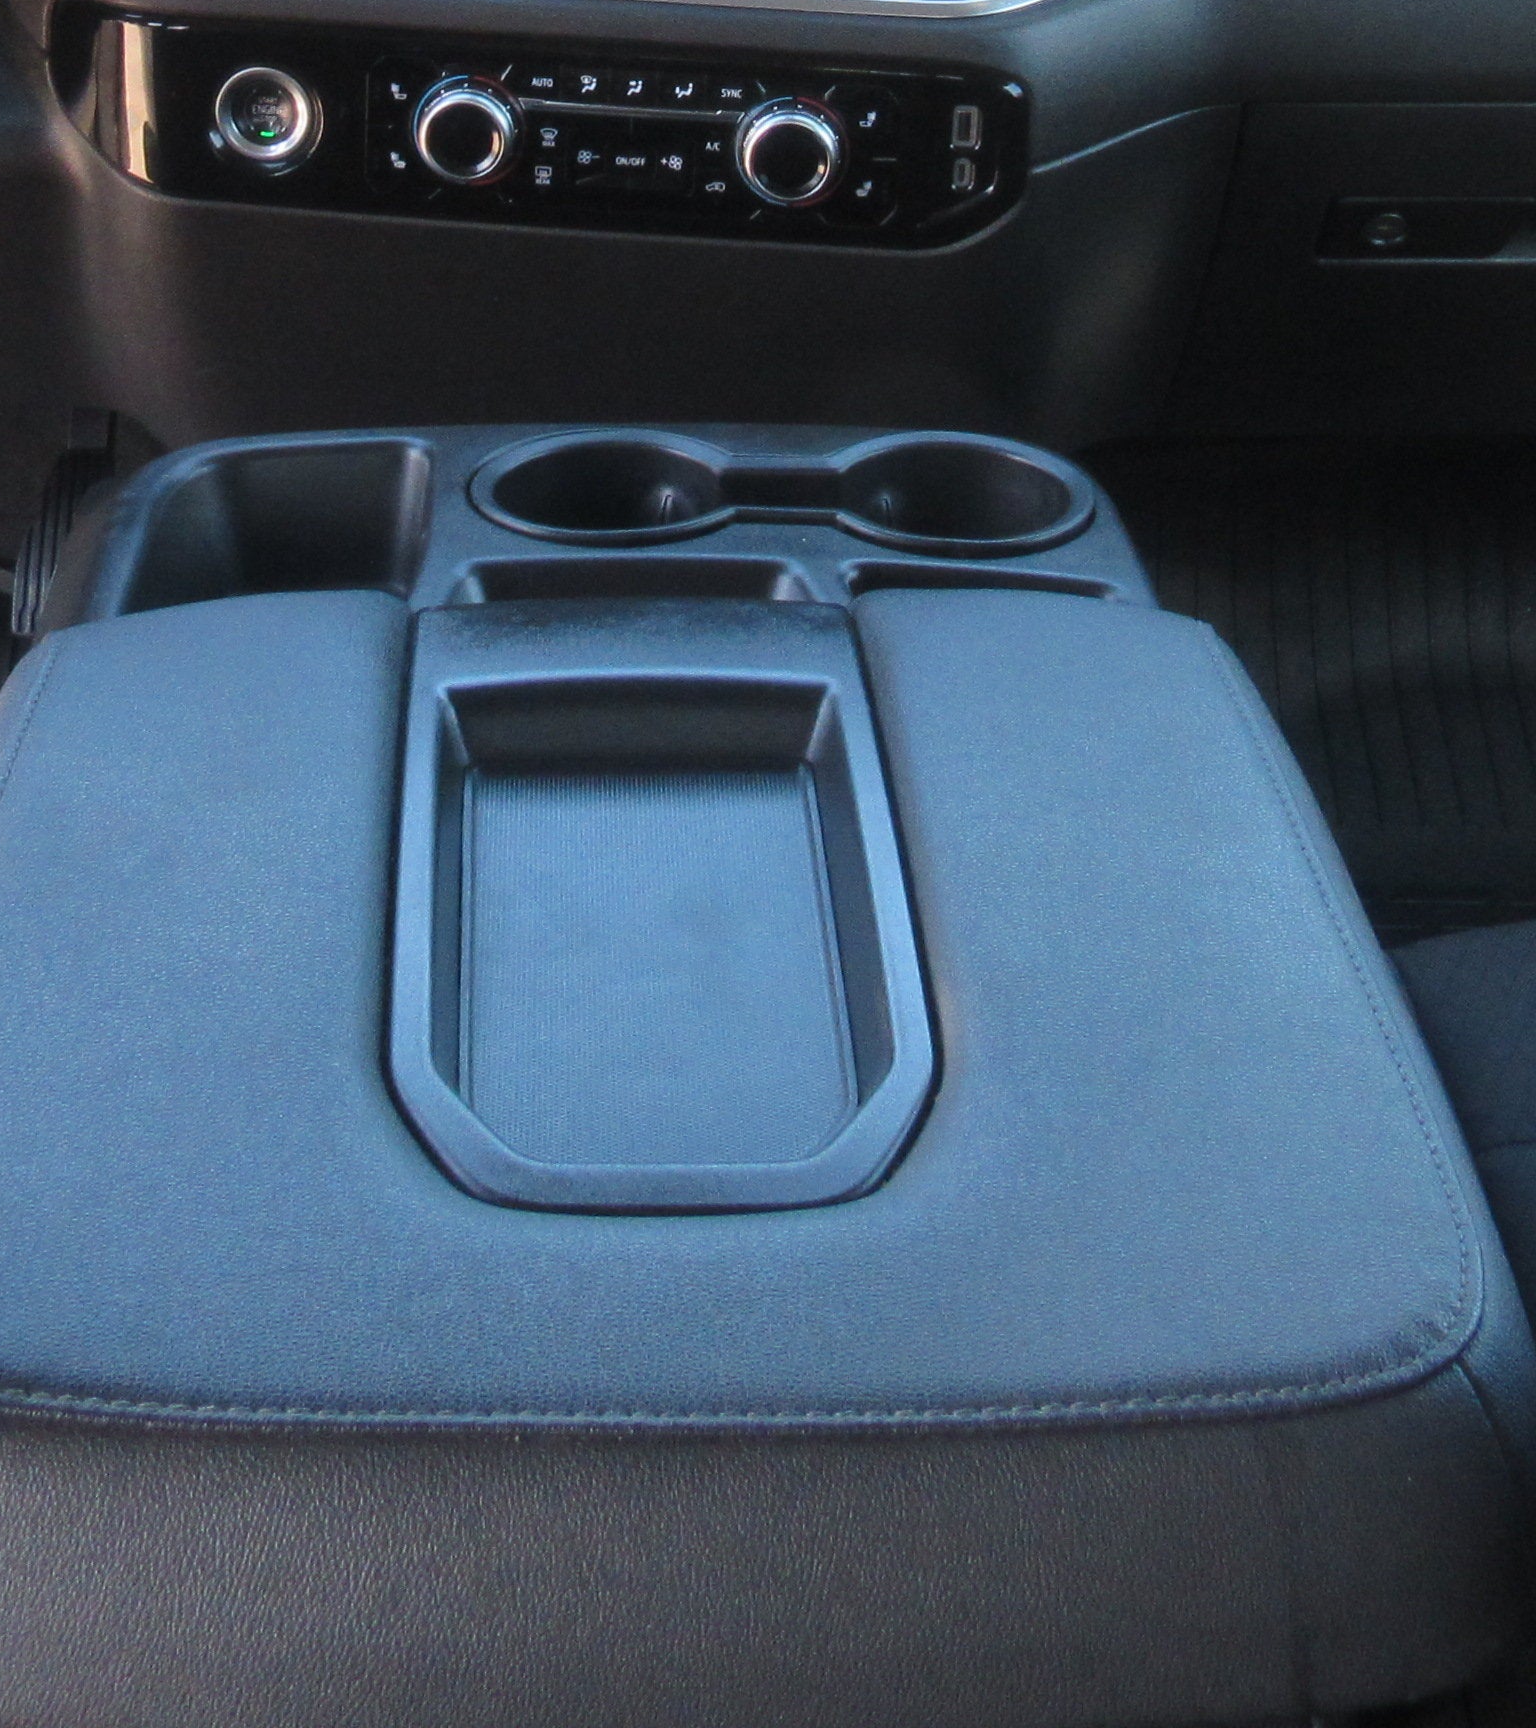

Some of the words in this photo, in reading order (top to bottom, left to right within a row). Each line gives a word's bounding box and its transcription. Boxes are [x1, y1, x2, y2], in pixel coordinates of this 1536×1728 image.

[531, 77, 554, 88] AUTO
[720, 88, 744, 100] SYNC
[705, 142, 721, 152] A/C
[615, 156, 647, 167] ON/OFF
